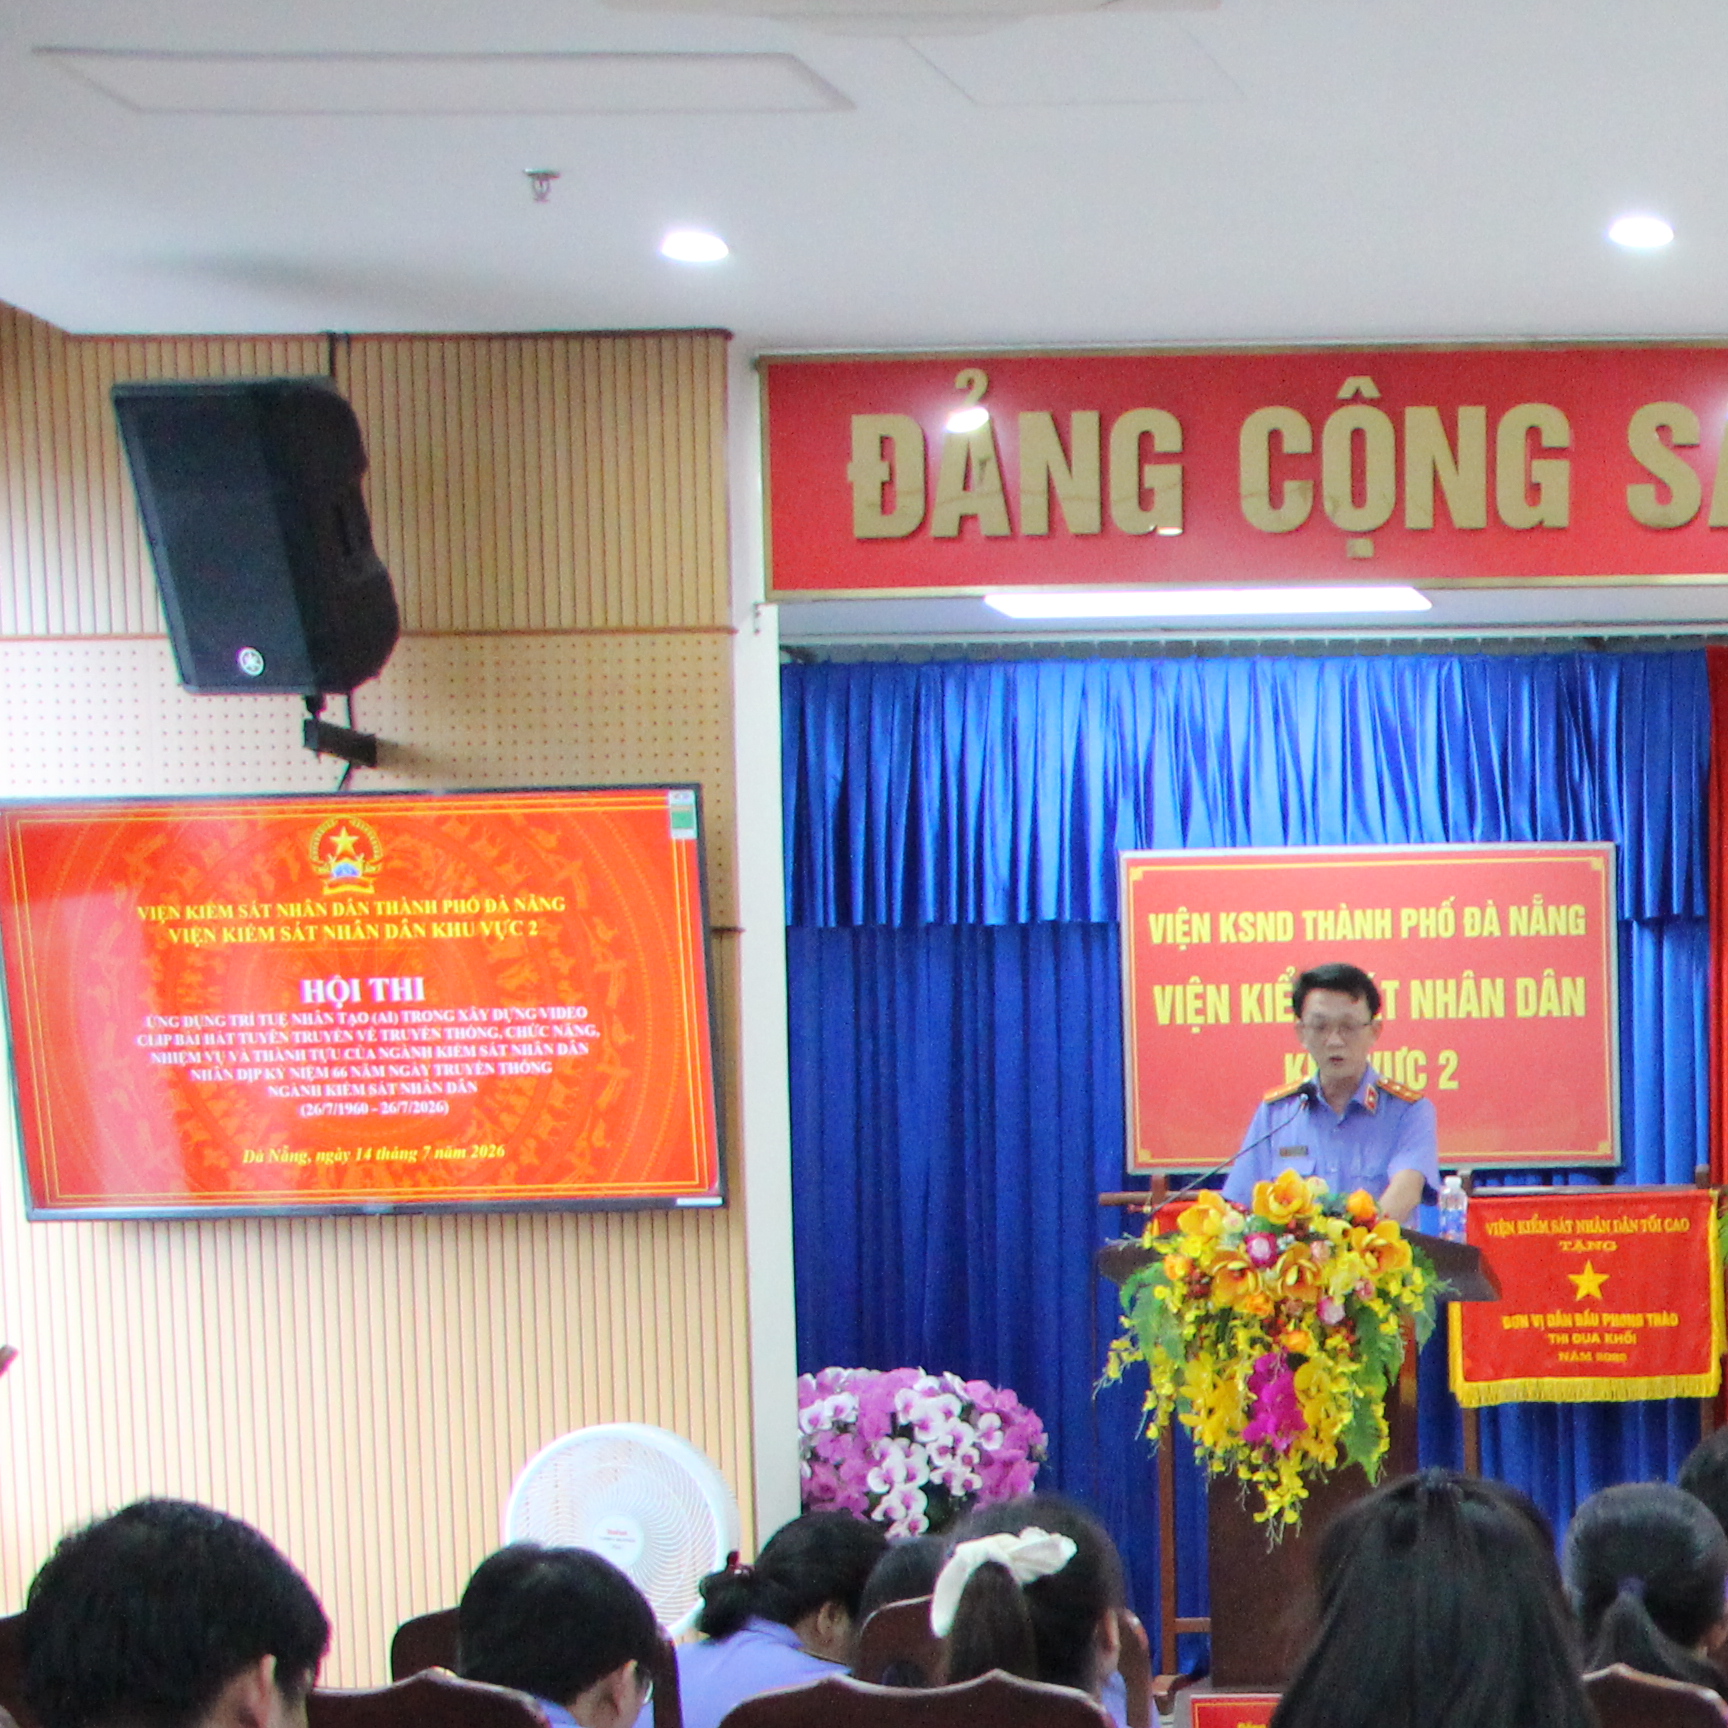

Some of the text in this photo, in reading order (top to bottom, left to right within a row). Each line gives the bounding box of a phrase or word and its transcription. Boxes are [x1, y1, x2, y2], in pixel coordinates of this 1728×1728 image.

[850, 367, 1184, 541] ĐẢNG
[1239, 376, 1571, 560] CỘNG
[137, 904, 181, 925] VIỆN
[238, 900, 273, 919] SÁT
[276, 897, 328, 919] NHÂN
[331, 897, 370, 918] DÂN
[373, 896, 438, 917] THÀNH
[1148, 893, 1586, 951] VIỆN KSND THÀNH PHỐ ĐÀ NẴNG
[168, 925, 217, 948] VIỆN
[279, 921, 319, 943] SÁT
[322, 920, 380, 941] NHÂN
[384, 919, 427, 941] DÂN
[431, 921, 475, 939] KHU
[528, 919, 539, 938] 2
[303, 974, 426, 1010] HỘI THI
[1153, 975, 1230, 1033] VIỆN
[1240, 966, 1296, 1023] KIỂ
[1410, 969, 1505, 1020] NHÂN
[1516, 966, 1587, 1018] DÂN
[1438, 1050, 1460, 1090] 2
[1664, 1217, 1691, 1233] CAO
